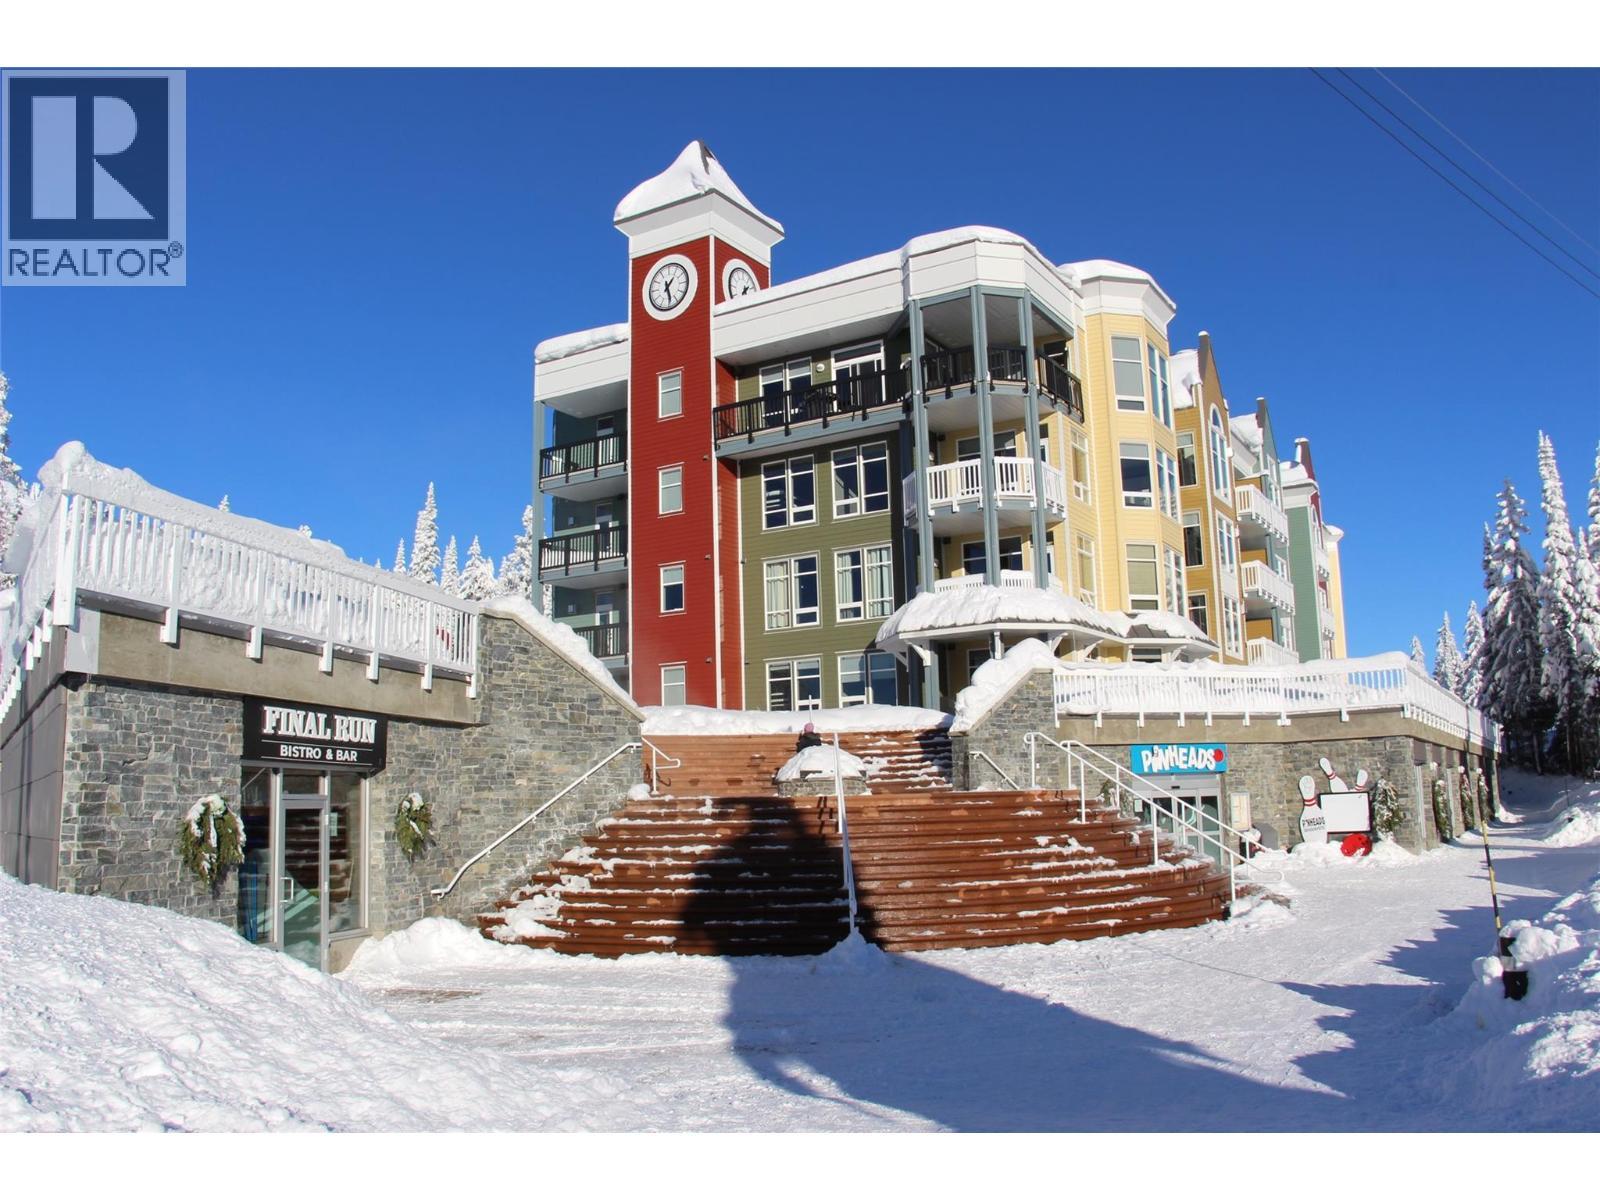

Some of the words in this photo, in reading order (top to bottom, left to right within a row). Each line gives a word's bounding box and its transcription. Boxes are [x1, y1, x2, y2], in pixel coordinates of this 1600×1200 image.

[262, 705, 331, 740] FINAL
[333, 714, 377, 743] RUN
[280, 744, 321, 759] BISTRO
[325, 749, 333, 760] &
[336, 750, 357, 762] BAR
